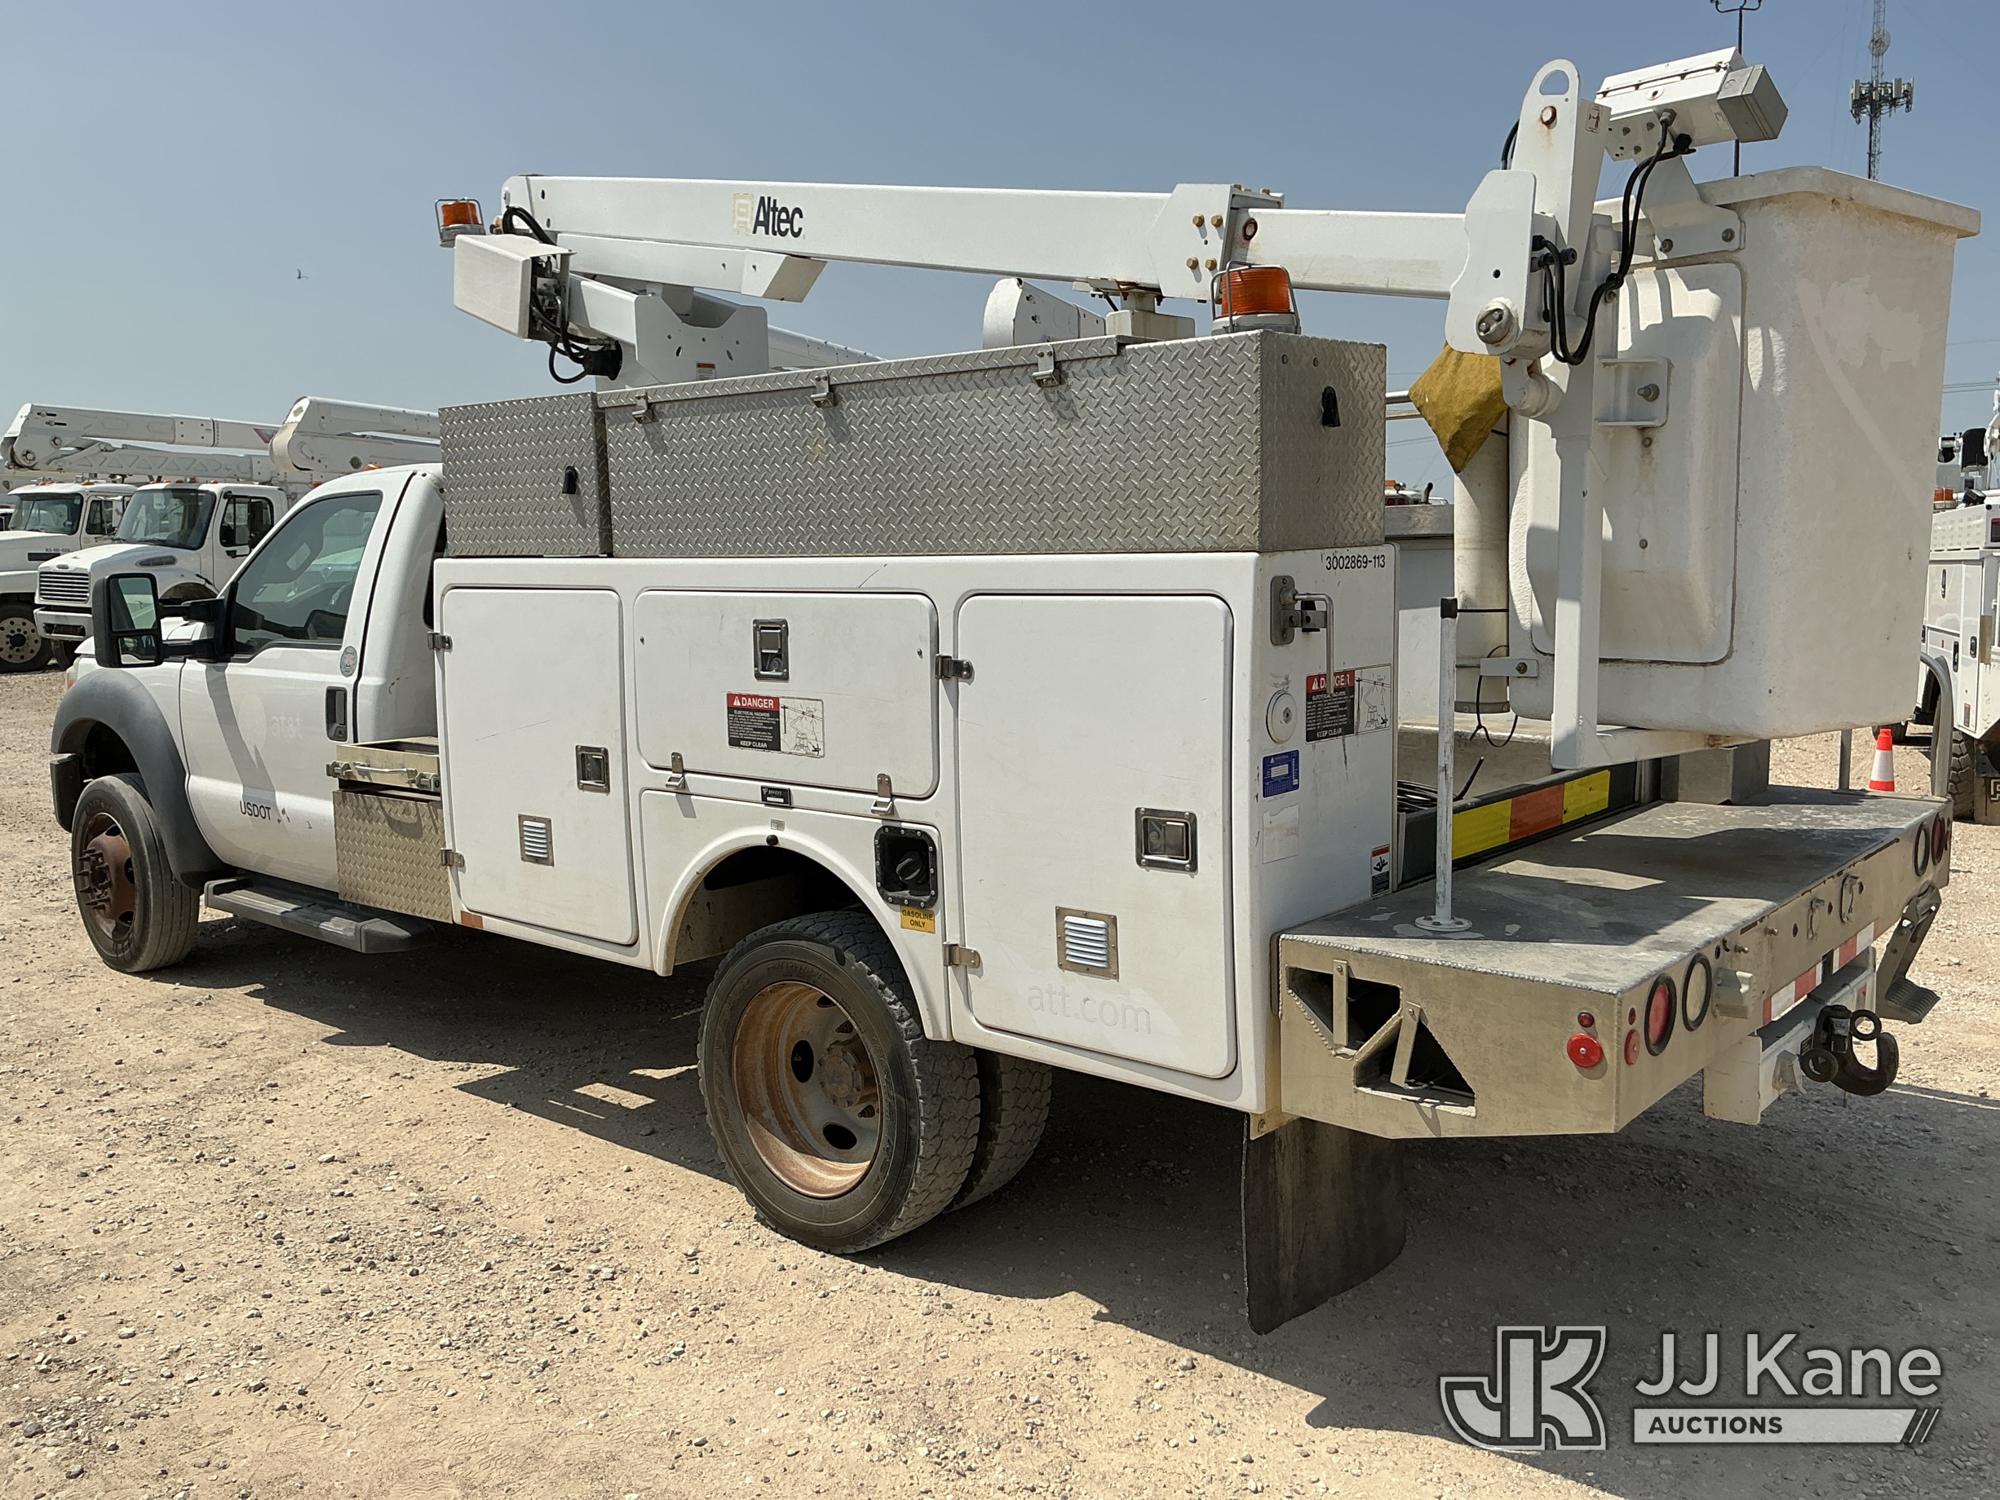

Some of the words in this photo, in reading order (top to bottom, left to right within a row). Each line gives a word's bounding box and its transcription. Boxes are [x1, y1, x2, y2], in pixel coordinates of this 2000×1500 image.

[752, 196, 803, 238] Altec
[1325, 554, 1386, 570] 3002869-113
[741, 697, 774, 709] DANGER
[240, 801, 271, 821] USDOT
[901, 909, 934, 921] GASOLINE
[909, 919, 926, 928] ONLY
[1027, 984, 1151, 1034] att.com
